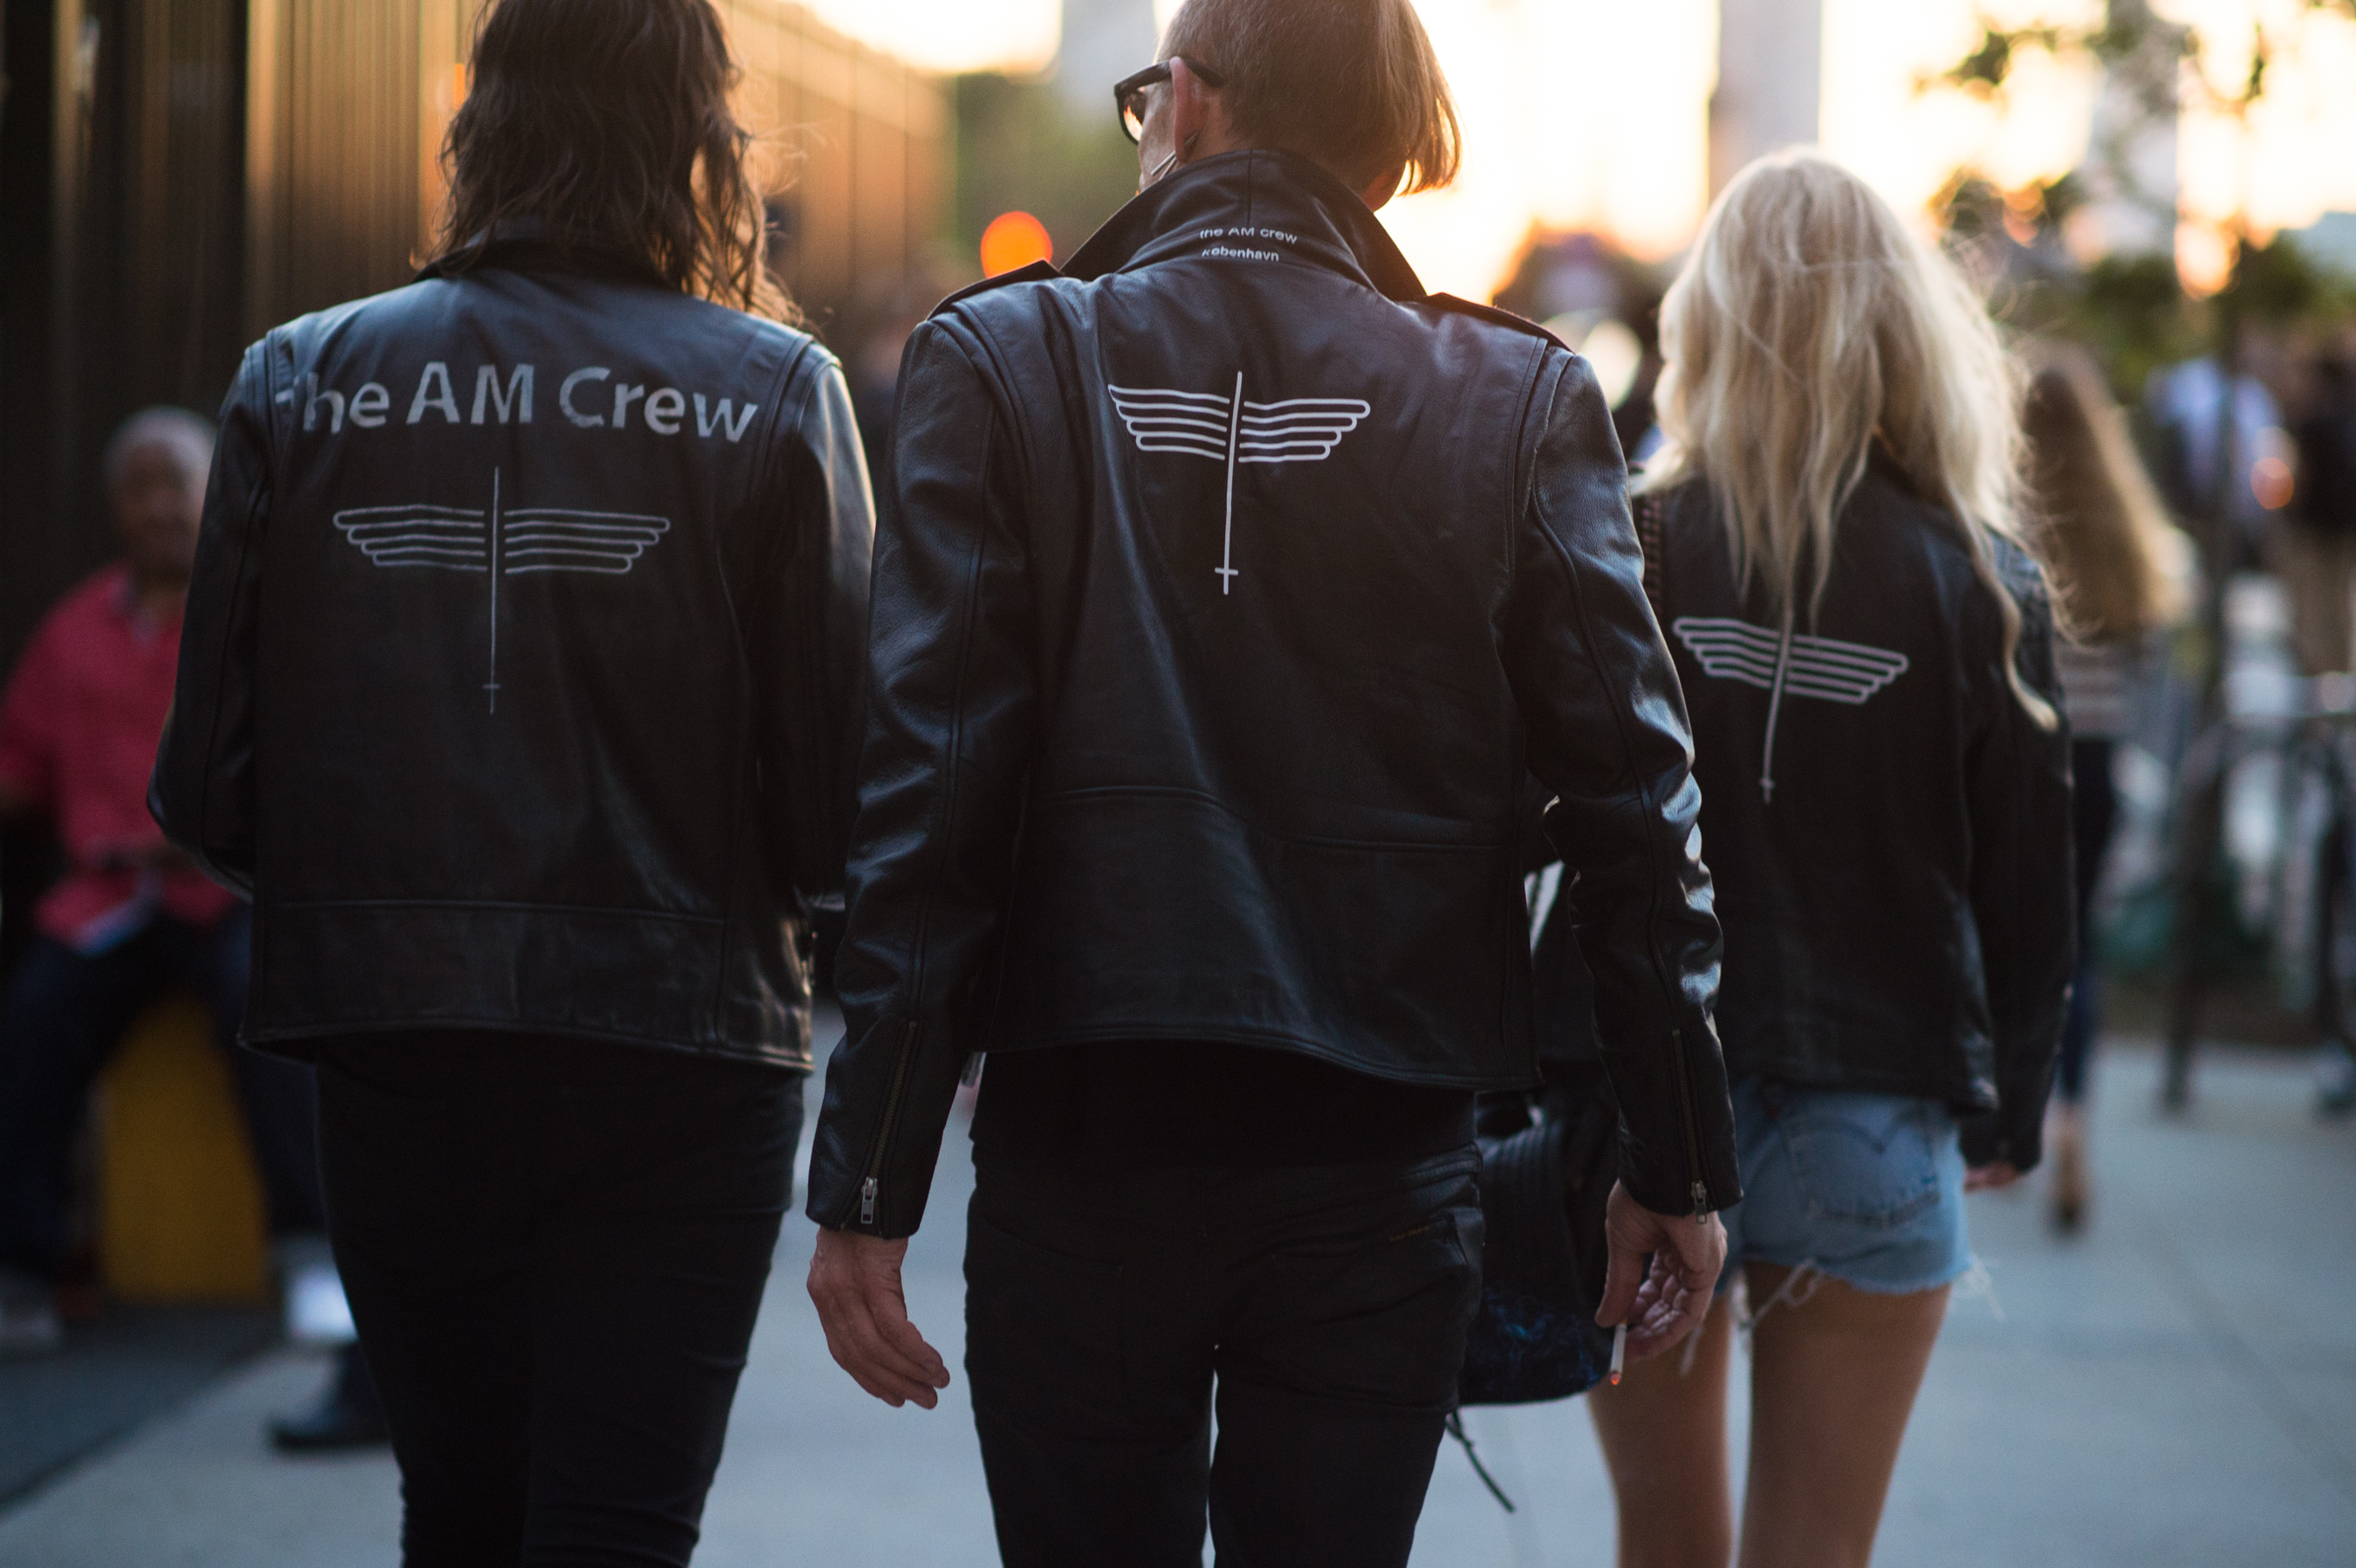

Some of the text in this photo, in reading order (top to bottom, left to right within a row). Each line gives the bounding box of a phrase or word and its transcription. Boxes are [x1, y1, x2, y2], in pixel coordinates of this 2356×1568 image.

[1228, 227, 1255, 236] AM
[1260, 228, 1298, 244] crew
[406, 361, 534, 425] AM
[559, 366, 758, 443] Crew
